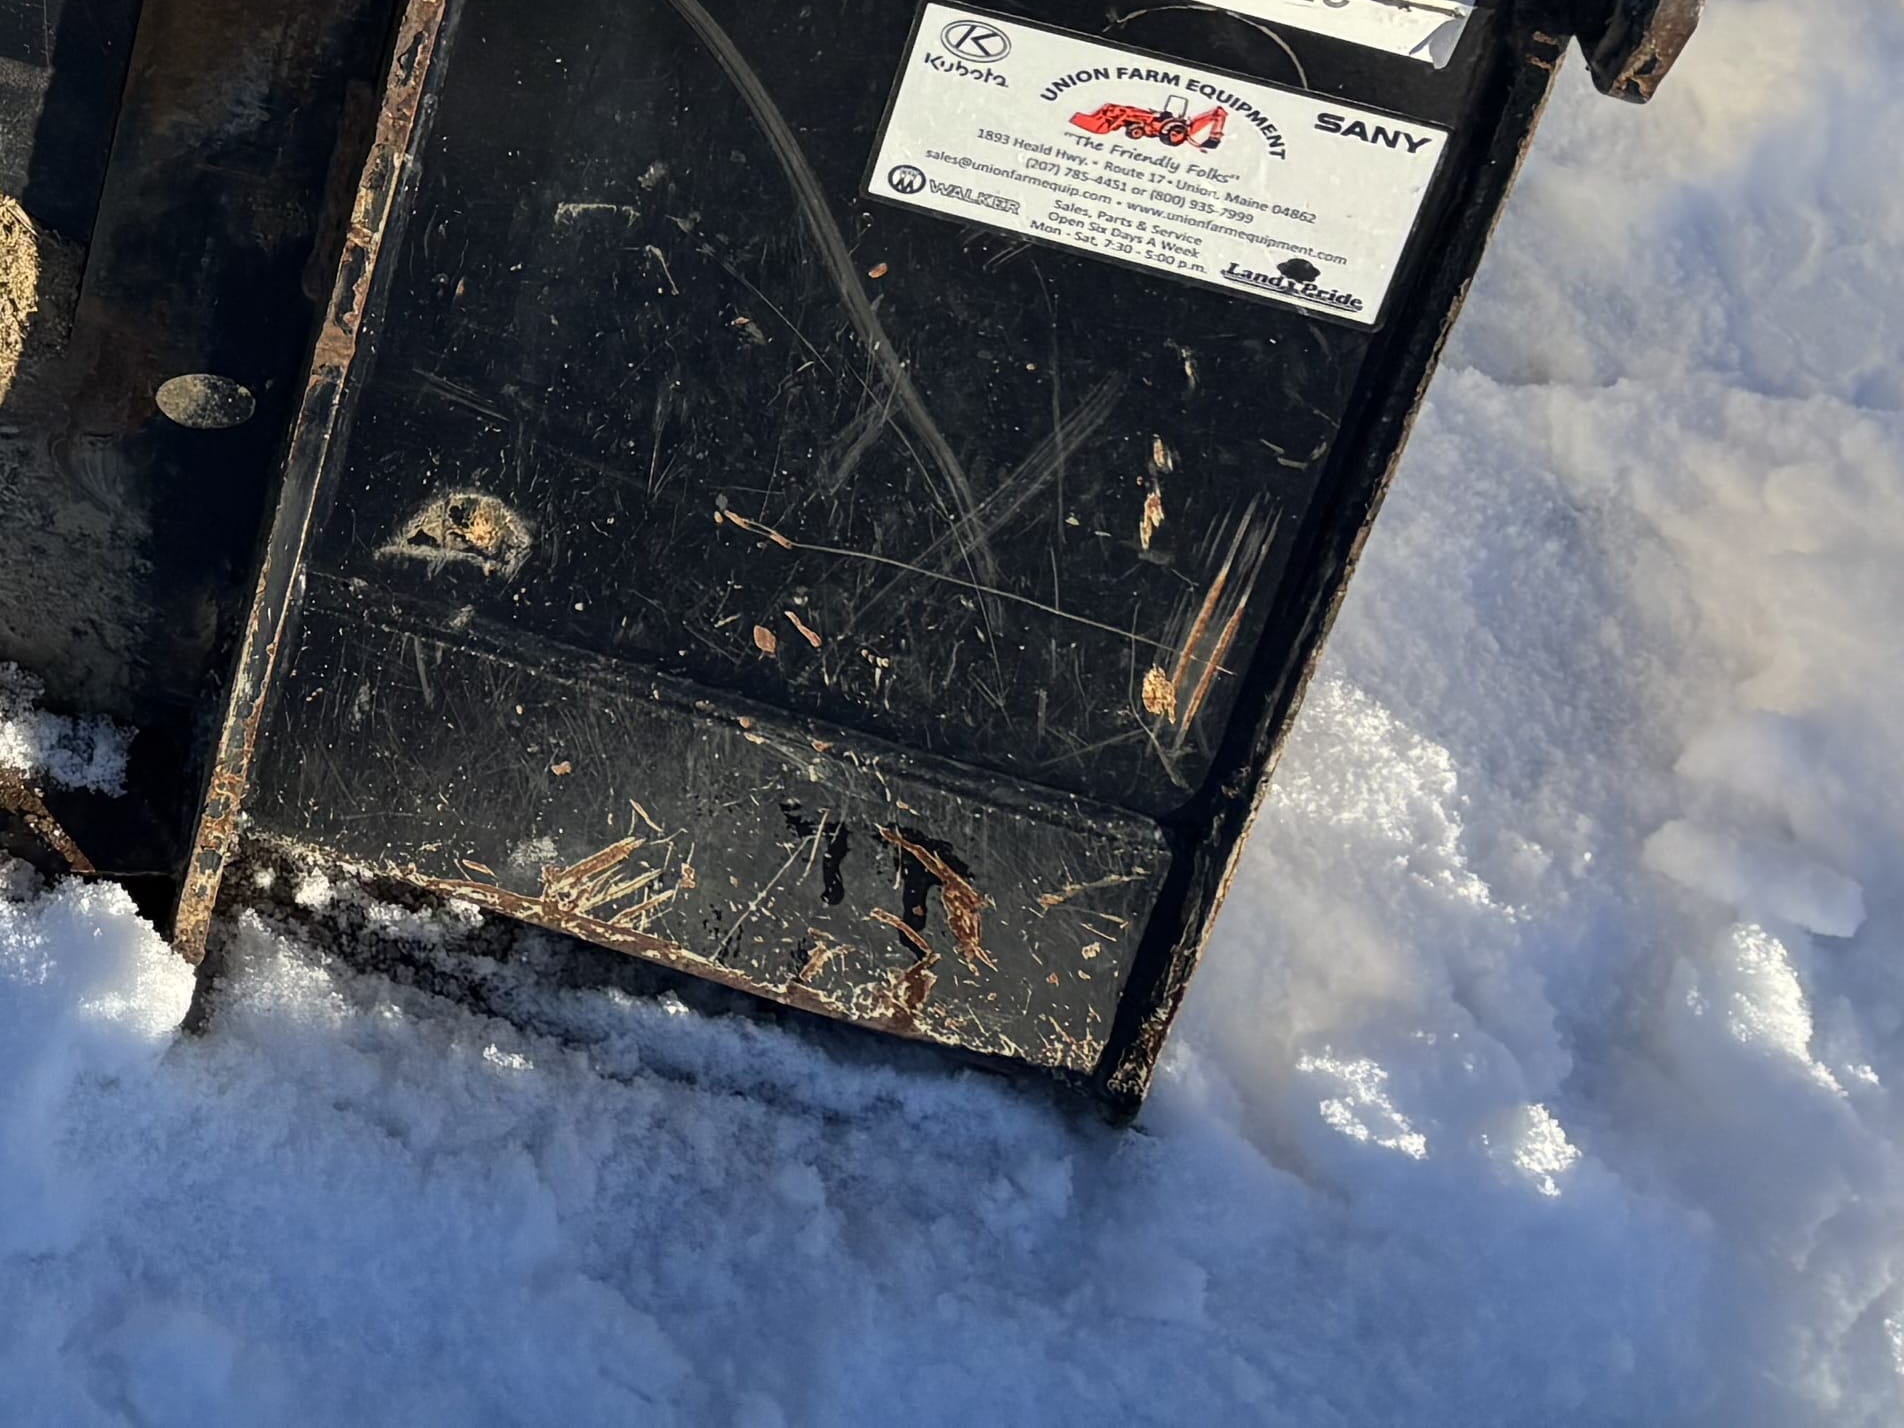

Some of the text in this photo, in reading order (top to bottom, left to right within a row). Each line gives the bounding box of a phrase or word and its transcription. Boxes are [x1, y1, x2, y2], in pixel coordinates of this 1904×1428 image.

[924, 52, 1009, 88] Kubota
[1040, 66, 1286, 160] UNION FARM EQUIPMENT
[1314, 111, 1432, 154] SANY
[977, 128, 1010, 145] 1893
[1013, 137, 1053, 156] Heald
[1055, 148, 1089, 166] Hwy.
[1103, 160, 1143, 180] Route
[1148, 172, 1165, 184] 17
[1224, 191, 1269, 212] Maine
[1271, 204, 1317, 224] 04862
[1109, 143, 1181, 174] Friendly
[925, 149, 1348, 265] sales@unionfarmequip.com www.unionfarmequipment.com
[929, 178, 1021, 215] WALKER
[1025, 156, 1254, 225] (207) 785-4451 or (800) 935-7999
[1030, 219, 1062, 236] Mon
[1103, 239, 1134, 254] 7:30
[1144, 249, 1175, 265] 5:00
[1178, 259, 1208, 274] p.m.
[1048, 211, 1201, 259] Open Six Days A Week
[1054, 199, 1203, 246] Sales, Parts & Service
[1221, 262, 1364, 311] Land Pride
